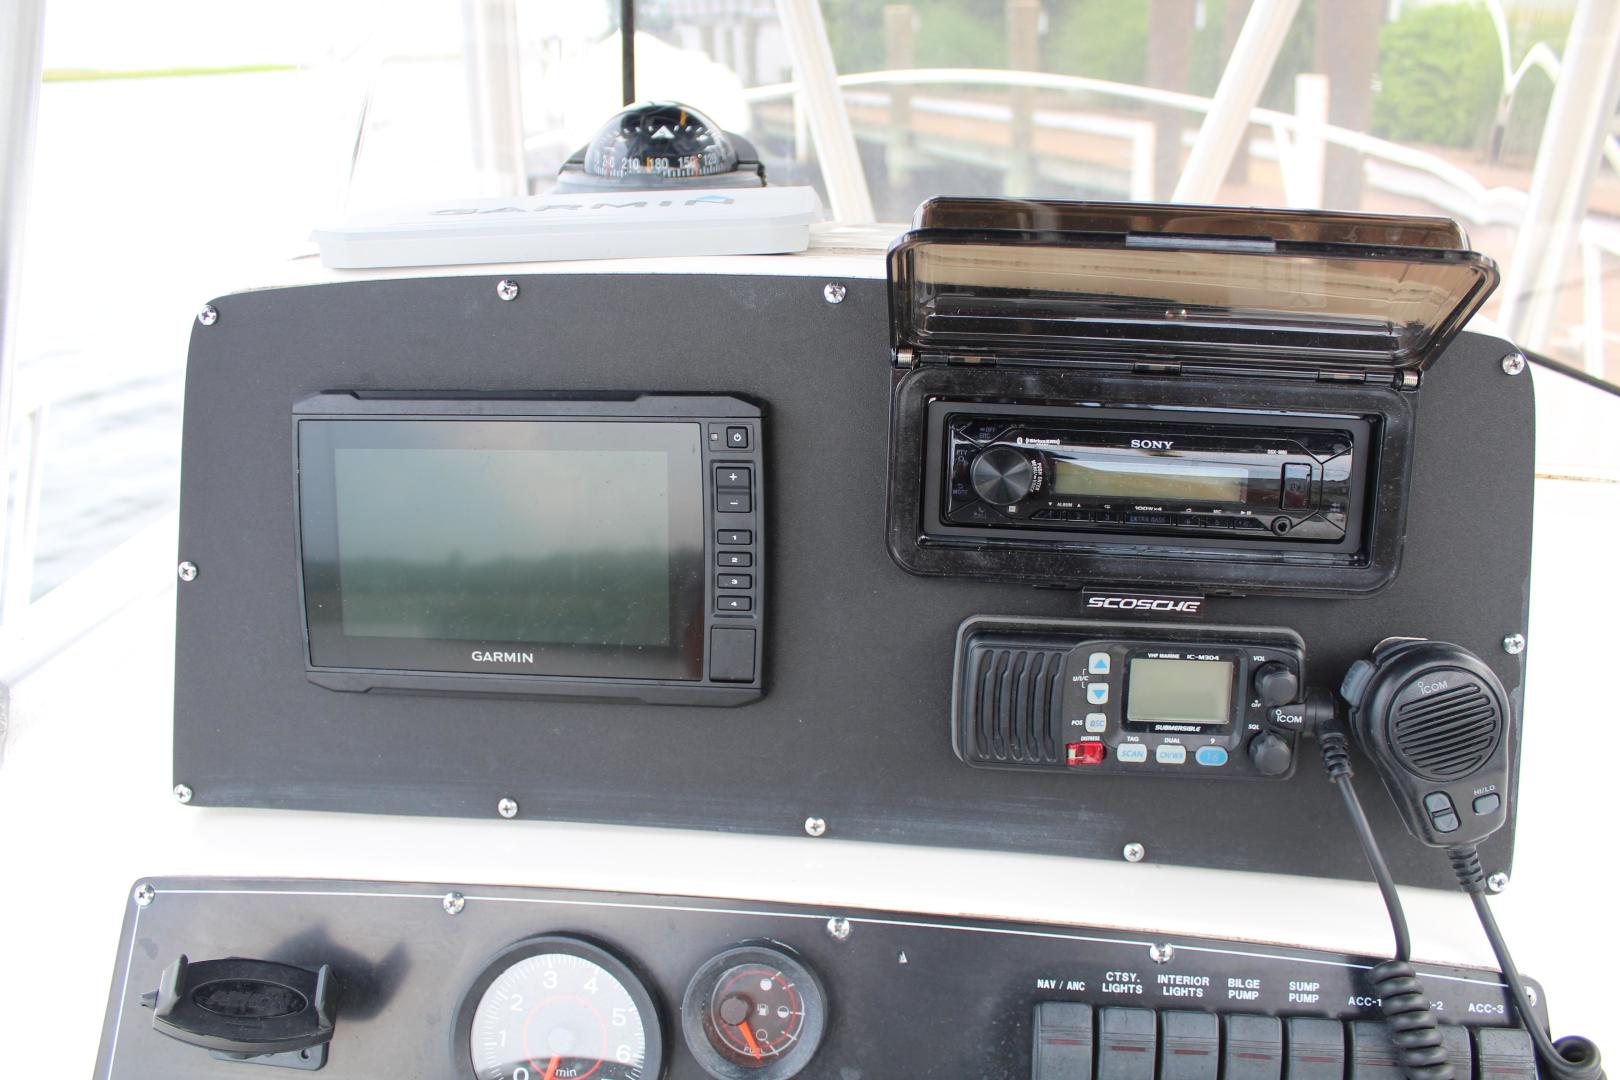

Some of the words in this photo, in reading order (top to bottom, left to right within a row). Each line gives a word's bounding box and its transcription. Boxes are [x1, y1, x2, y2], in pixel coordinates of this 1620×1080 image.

[621, 157, 640, 170] 210
[649, 157, 669, 170] 180
[430, 194, 735, 216] GARMIN
[1130, 439, 1175, 450] SONY
[1087, 597, 1201, 613] SCOSCHE
[471, 651, 534, 664] GARMIN
[1154, 724, 1202, 732] SUBMERSIBLE
[1127, 735, 1140, 743] TAG
[1474, 784, 1496, 796] HI/LO
[543, 970, 558, 990] 3
[1105, 971, 1141, 983] CTSY.
[1157, 974, 1210, 987] INTERIOR
[583, 977, 599, 995] 4
[1037, 979, 1056, 990] NAV
[1066, 980, 1086, 992] ANC
[1101, 982, 1143, 995] LIGHTS
[1227, 978, 1260, 990] BILGE
[1289, 981, 1320, 992] SUMP
[1162, 986, 1204, 998] LIGHTS
[1228, 989, 1259, 1001] PUMP
[1288, 993, 1320, 1004] PUMP
[510, 994, 524, 1012] 2
[1347, 995, 1383, 1008] ACC-1
[1468, 1003, 1505, 1015] ACC-3
[611, 1007, 628, 1026] 5
[499, 1031, 507, 1048] 1
[616, 1044, 632, 1063] 6
